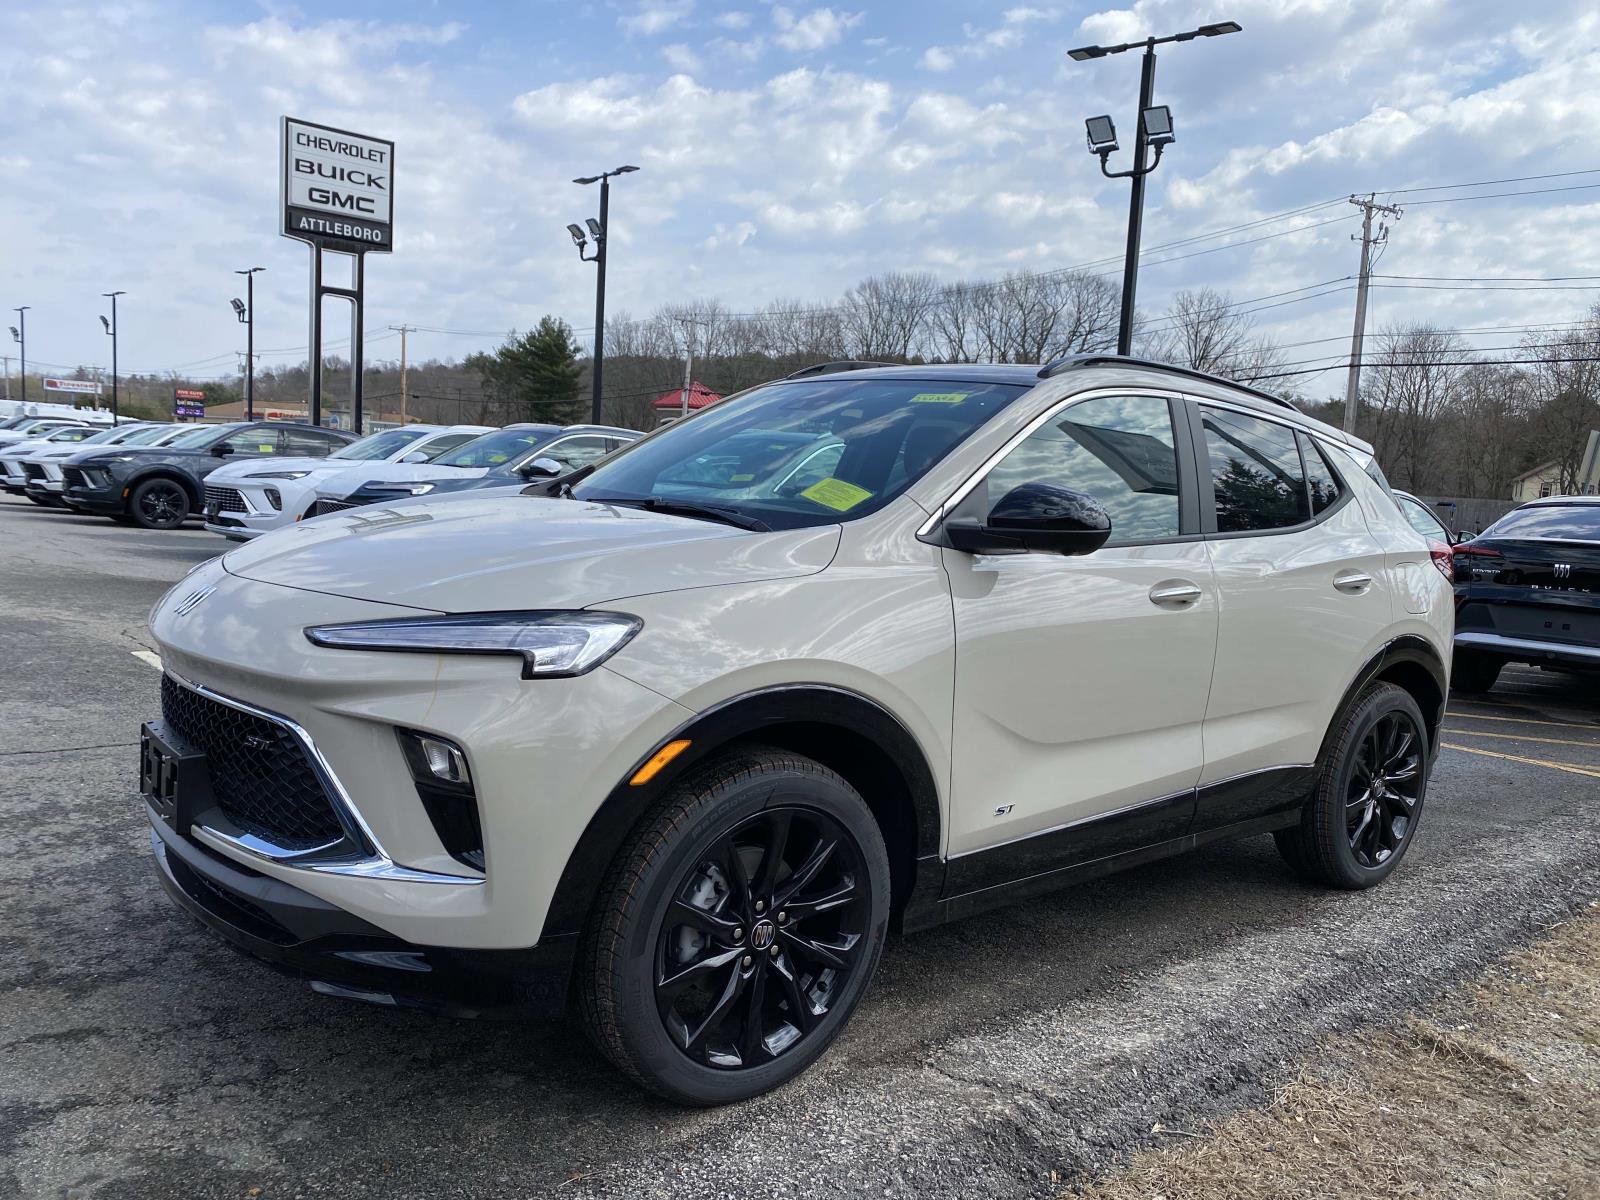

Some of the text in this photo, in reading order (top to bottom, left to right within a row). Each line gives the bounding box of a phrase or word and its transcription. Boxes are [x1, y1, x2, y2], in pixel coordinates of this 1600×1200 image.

[296, 132, 386, 163] CHEVROLET
[294, 158, 386, 190] BUICK
[308, 187, 375, 213] GMC
[299, 216, 382, 241] ATTLEBORO
[1531, 584, 1590, 592] BUICK
[993, 803, 1017, 816] ST
